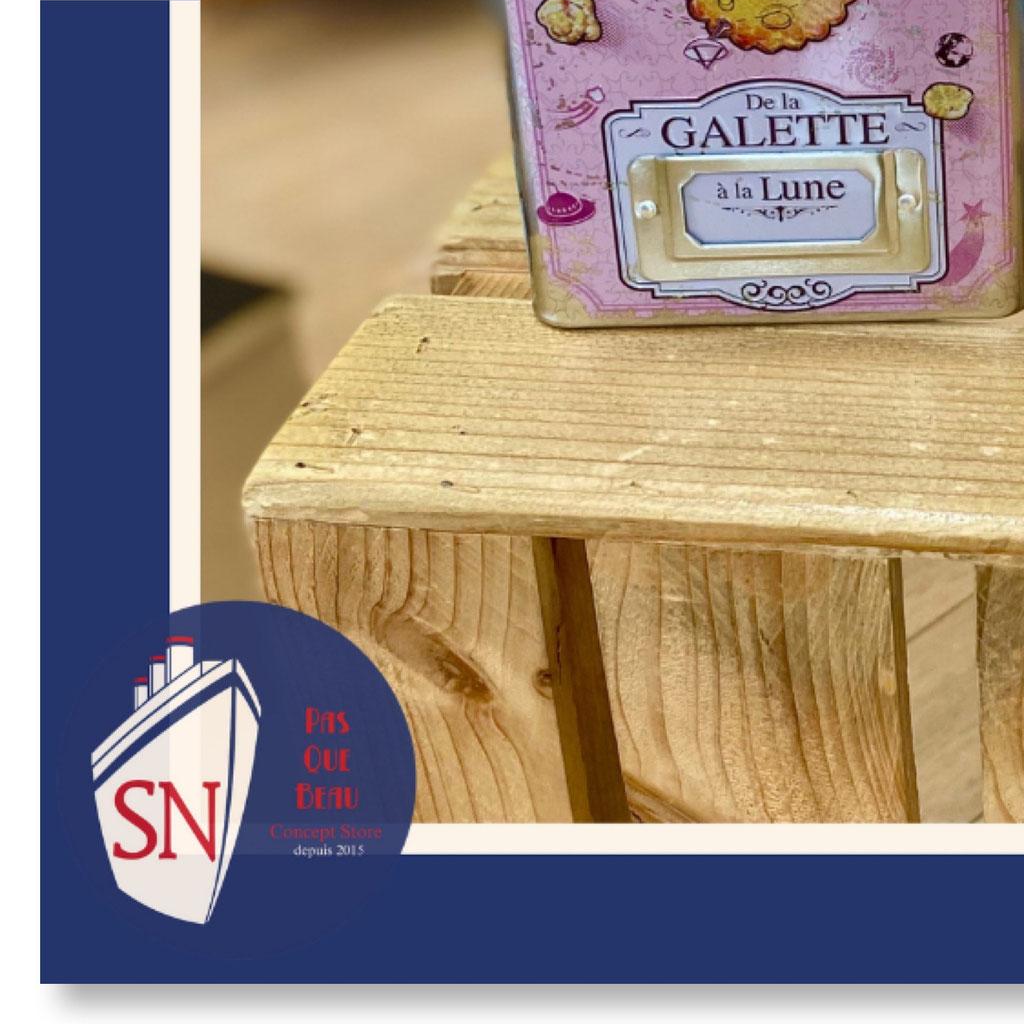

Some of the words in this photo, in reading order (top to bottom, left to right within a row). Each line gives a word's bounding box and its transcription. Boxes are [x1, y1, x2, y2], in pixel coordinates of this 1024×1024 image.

[746, 93, 775, 110] De
[783, 92, 800, 109] la
[661, 112, 890, 149] GALETTE
[717, 181, 729, 199] à
[735, 178, 752, 199] la
[761, 176, 846, 201] Lune
